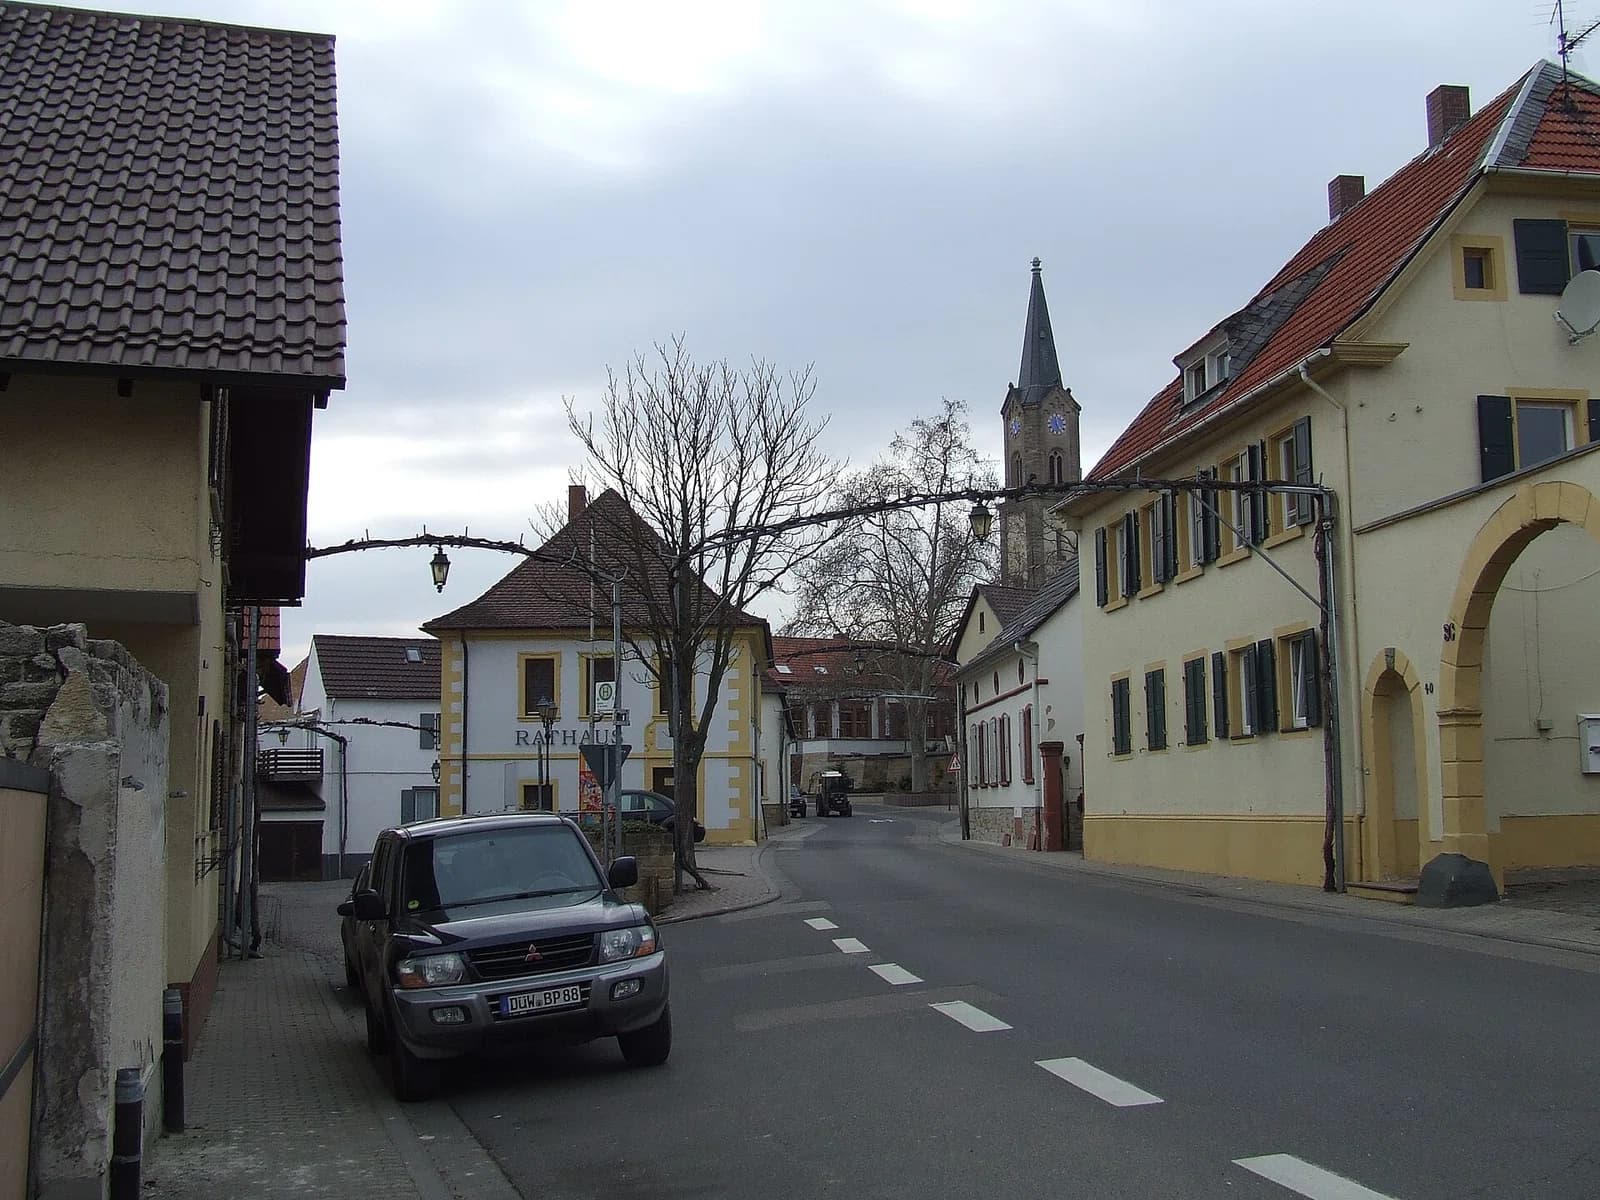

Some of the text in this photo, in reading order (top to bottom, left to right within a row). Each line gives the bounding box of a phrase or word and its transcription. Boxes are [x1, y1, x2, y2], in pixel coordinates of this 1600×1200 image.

[514, 729, 624, 746] RATHAUS
[543, 990, 560, 1006] BP
[563, 987, 579, 1002] 88
